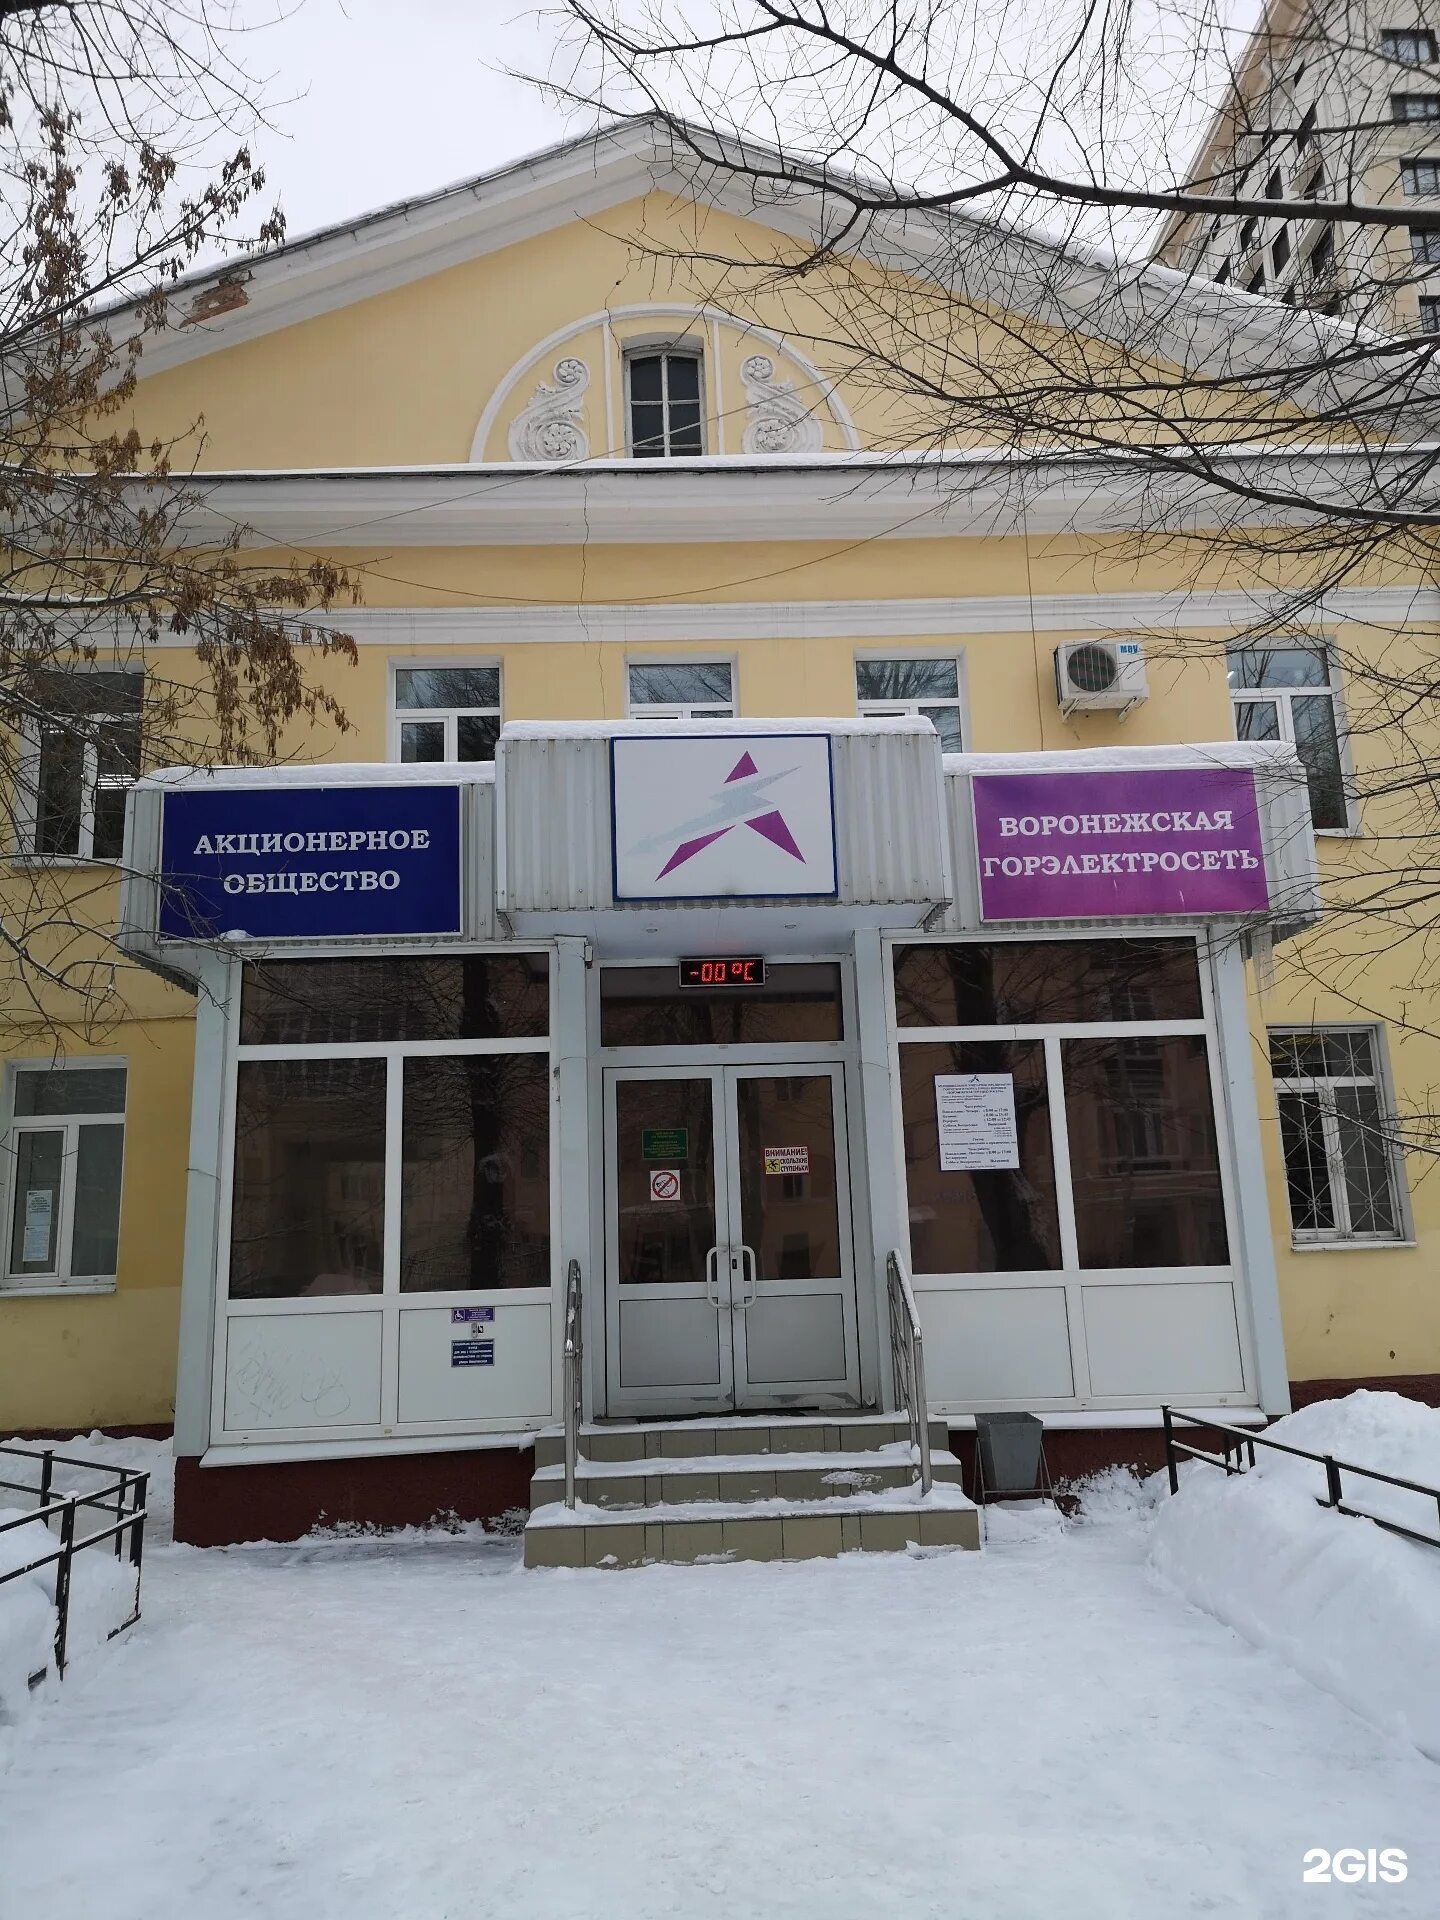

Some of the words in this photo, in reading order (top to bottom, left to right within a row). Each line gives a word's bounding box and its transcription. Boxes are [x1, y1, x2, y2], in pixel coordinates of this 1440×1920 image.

[999, 810, 1235, 837] ВОРОНЕЖСКАЯ
[193, 829, 431, 857] АКЦИОНЕРНОЕ
[982, 849, 1259, 877] ГОРЭЛЕКТРОСЕТЬ
[223, 870, 401, 896] ОБЩЕСТВО
[765, 1147, 808, 1157] ВНИМАНИЕ!
